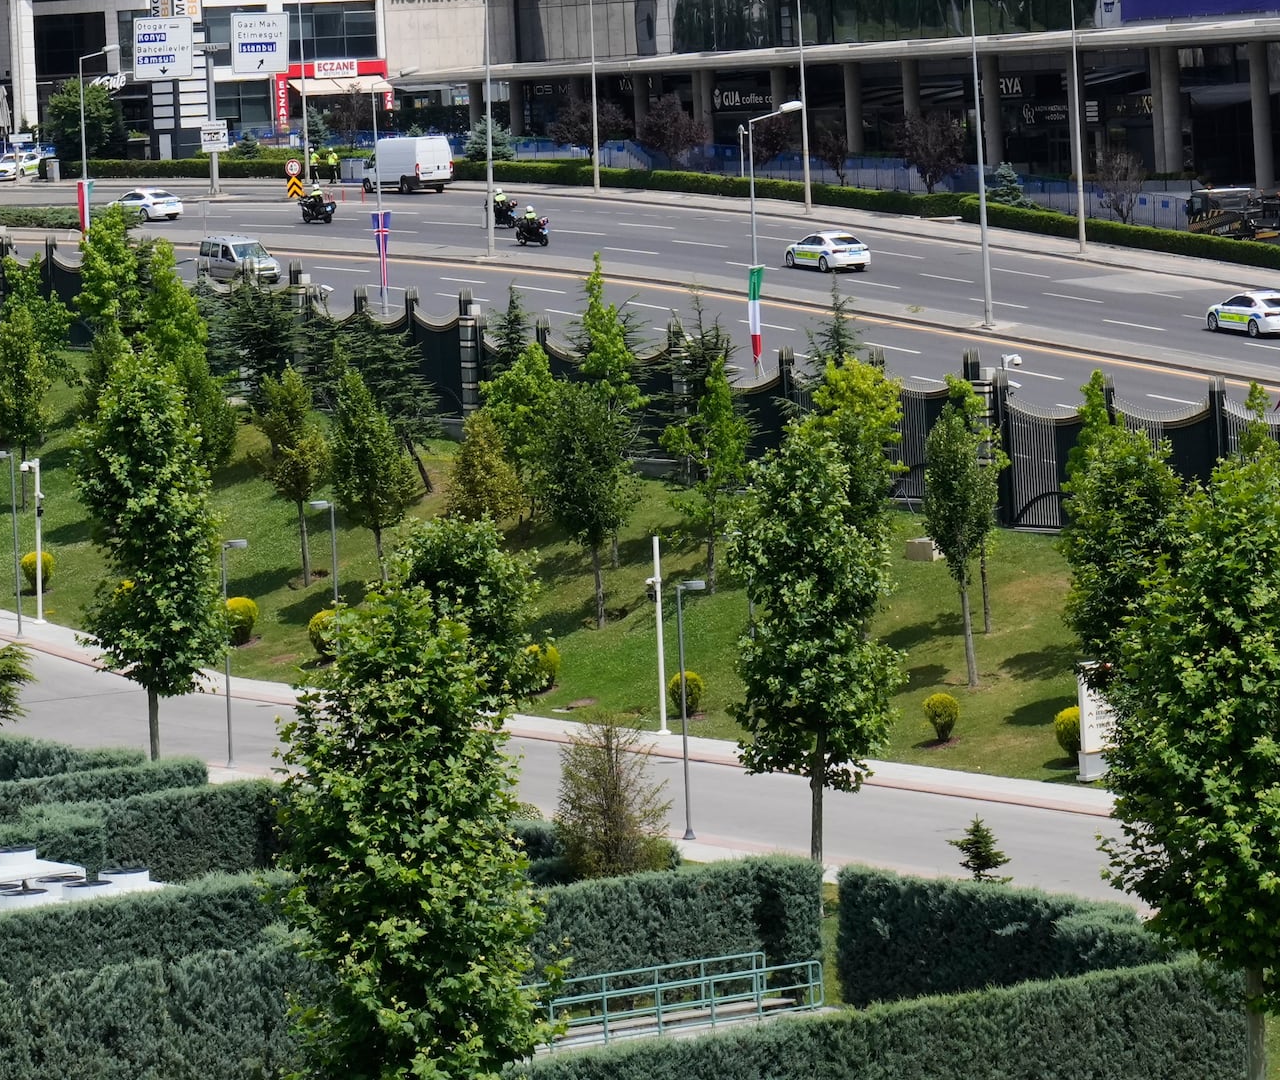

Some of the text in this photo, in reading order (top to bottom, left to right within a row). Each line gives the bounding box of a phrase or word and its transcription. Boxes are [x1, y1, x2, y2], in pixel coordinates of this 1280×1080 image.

[138, 33, 166, 42] Konya
[238, 31, 282, 40] Etimesgut
[138, 55, 175, 64] Samsun
[317, 62, 355, 72] ECZANE
[723, 91, 741, 106] GUA
[742, 93, 763, 104] coffee
